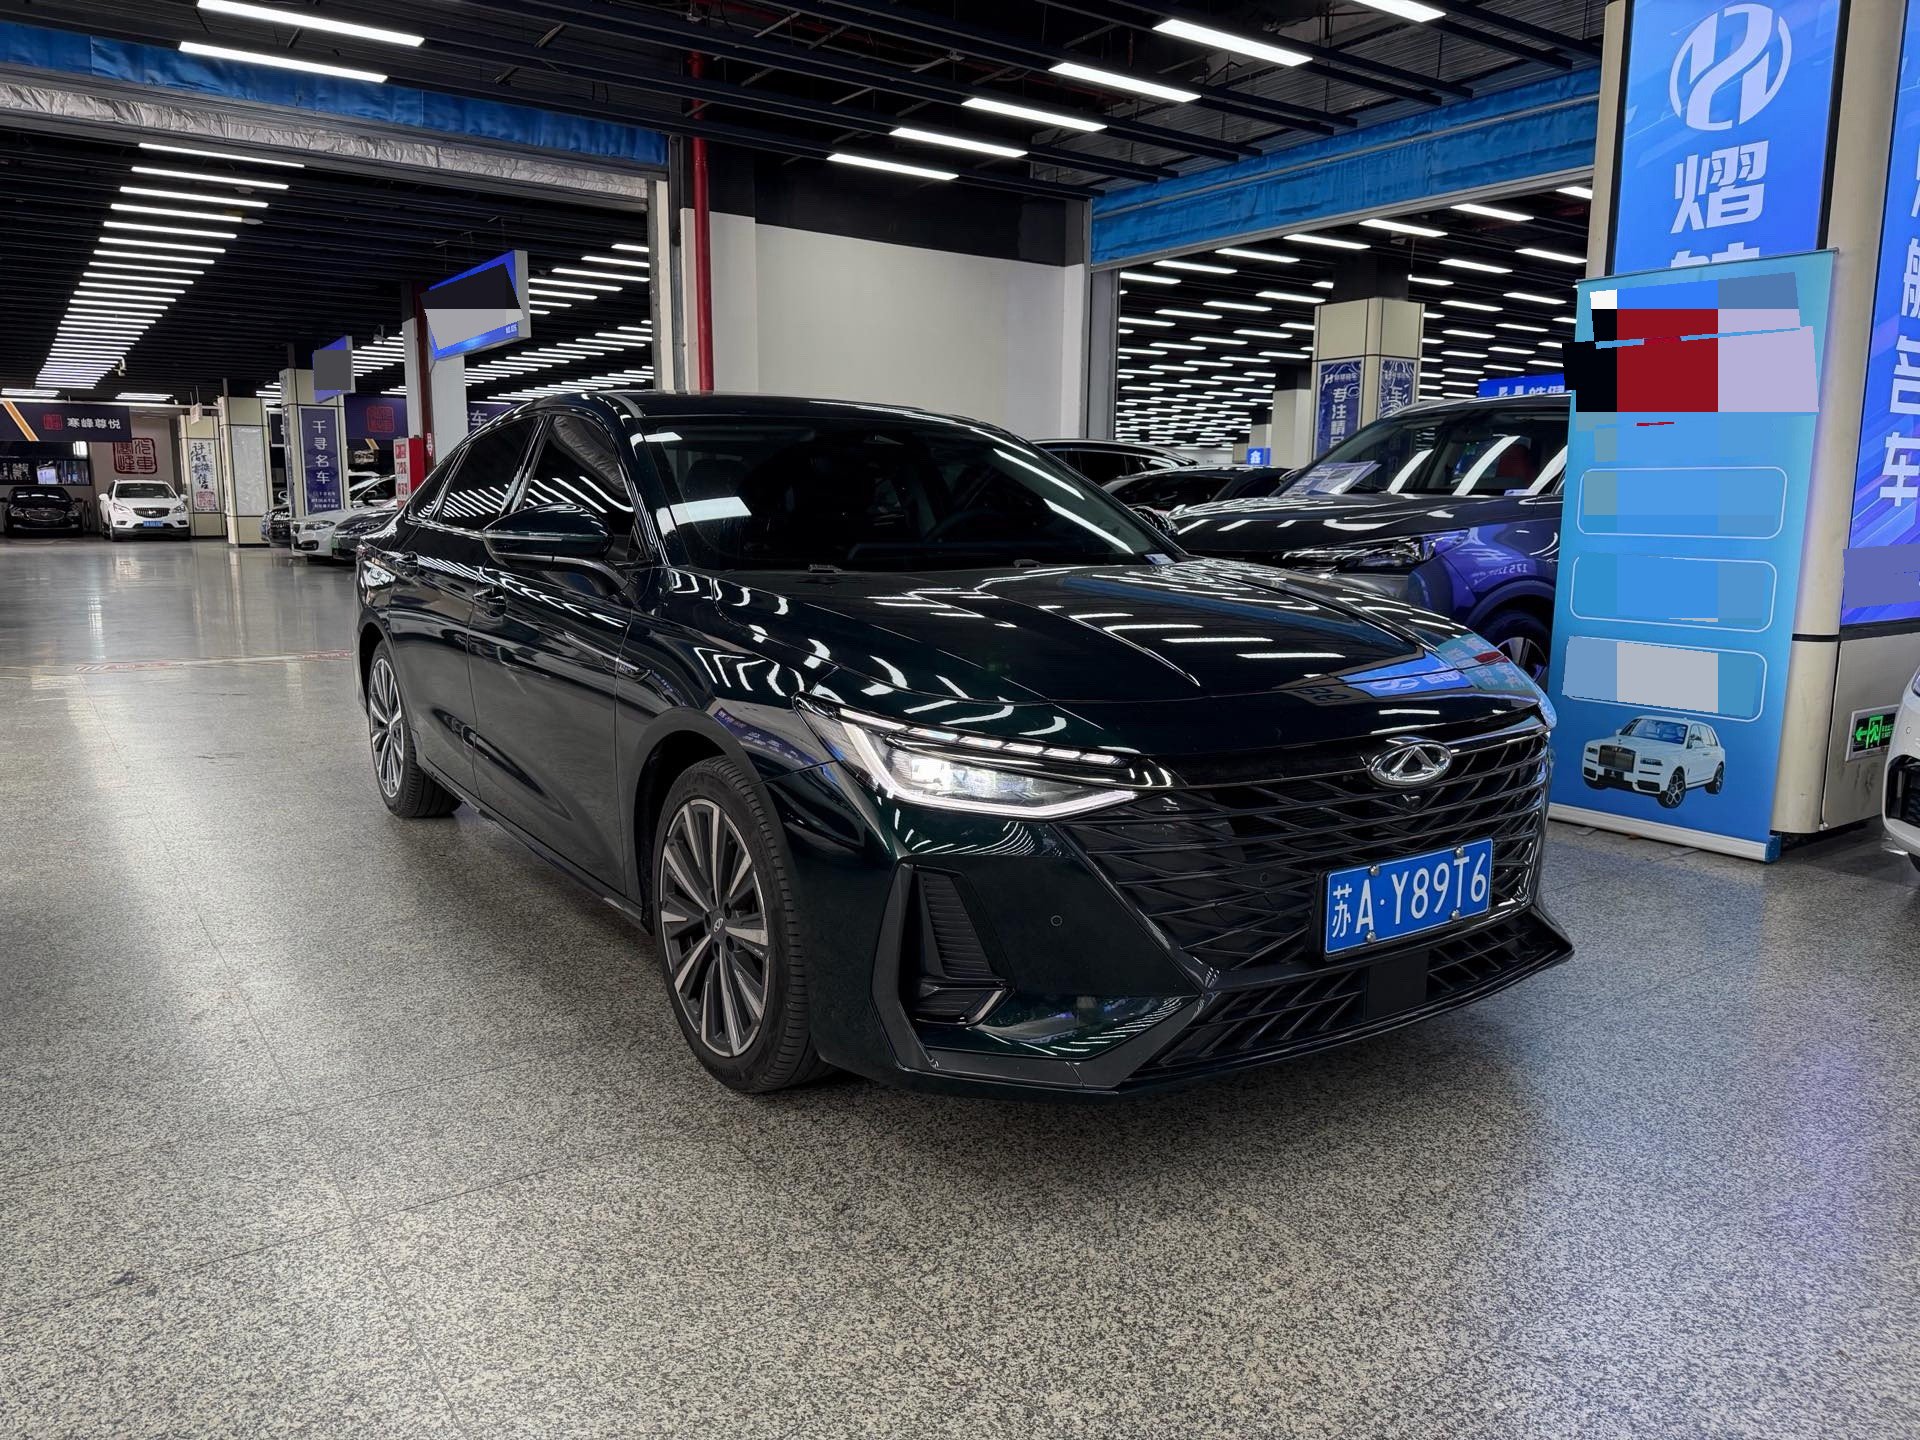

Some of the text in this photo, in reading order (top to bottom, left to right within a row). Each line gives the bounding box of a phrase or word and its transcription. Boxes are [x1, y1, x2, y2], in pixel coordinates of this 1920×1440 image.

[1670, 140, 1769, 269] 熠
[312, 420, 331, 484] 千寻名车
